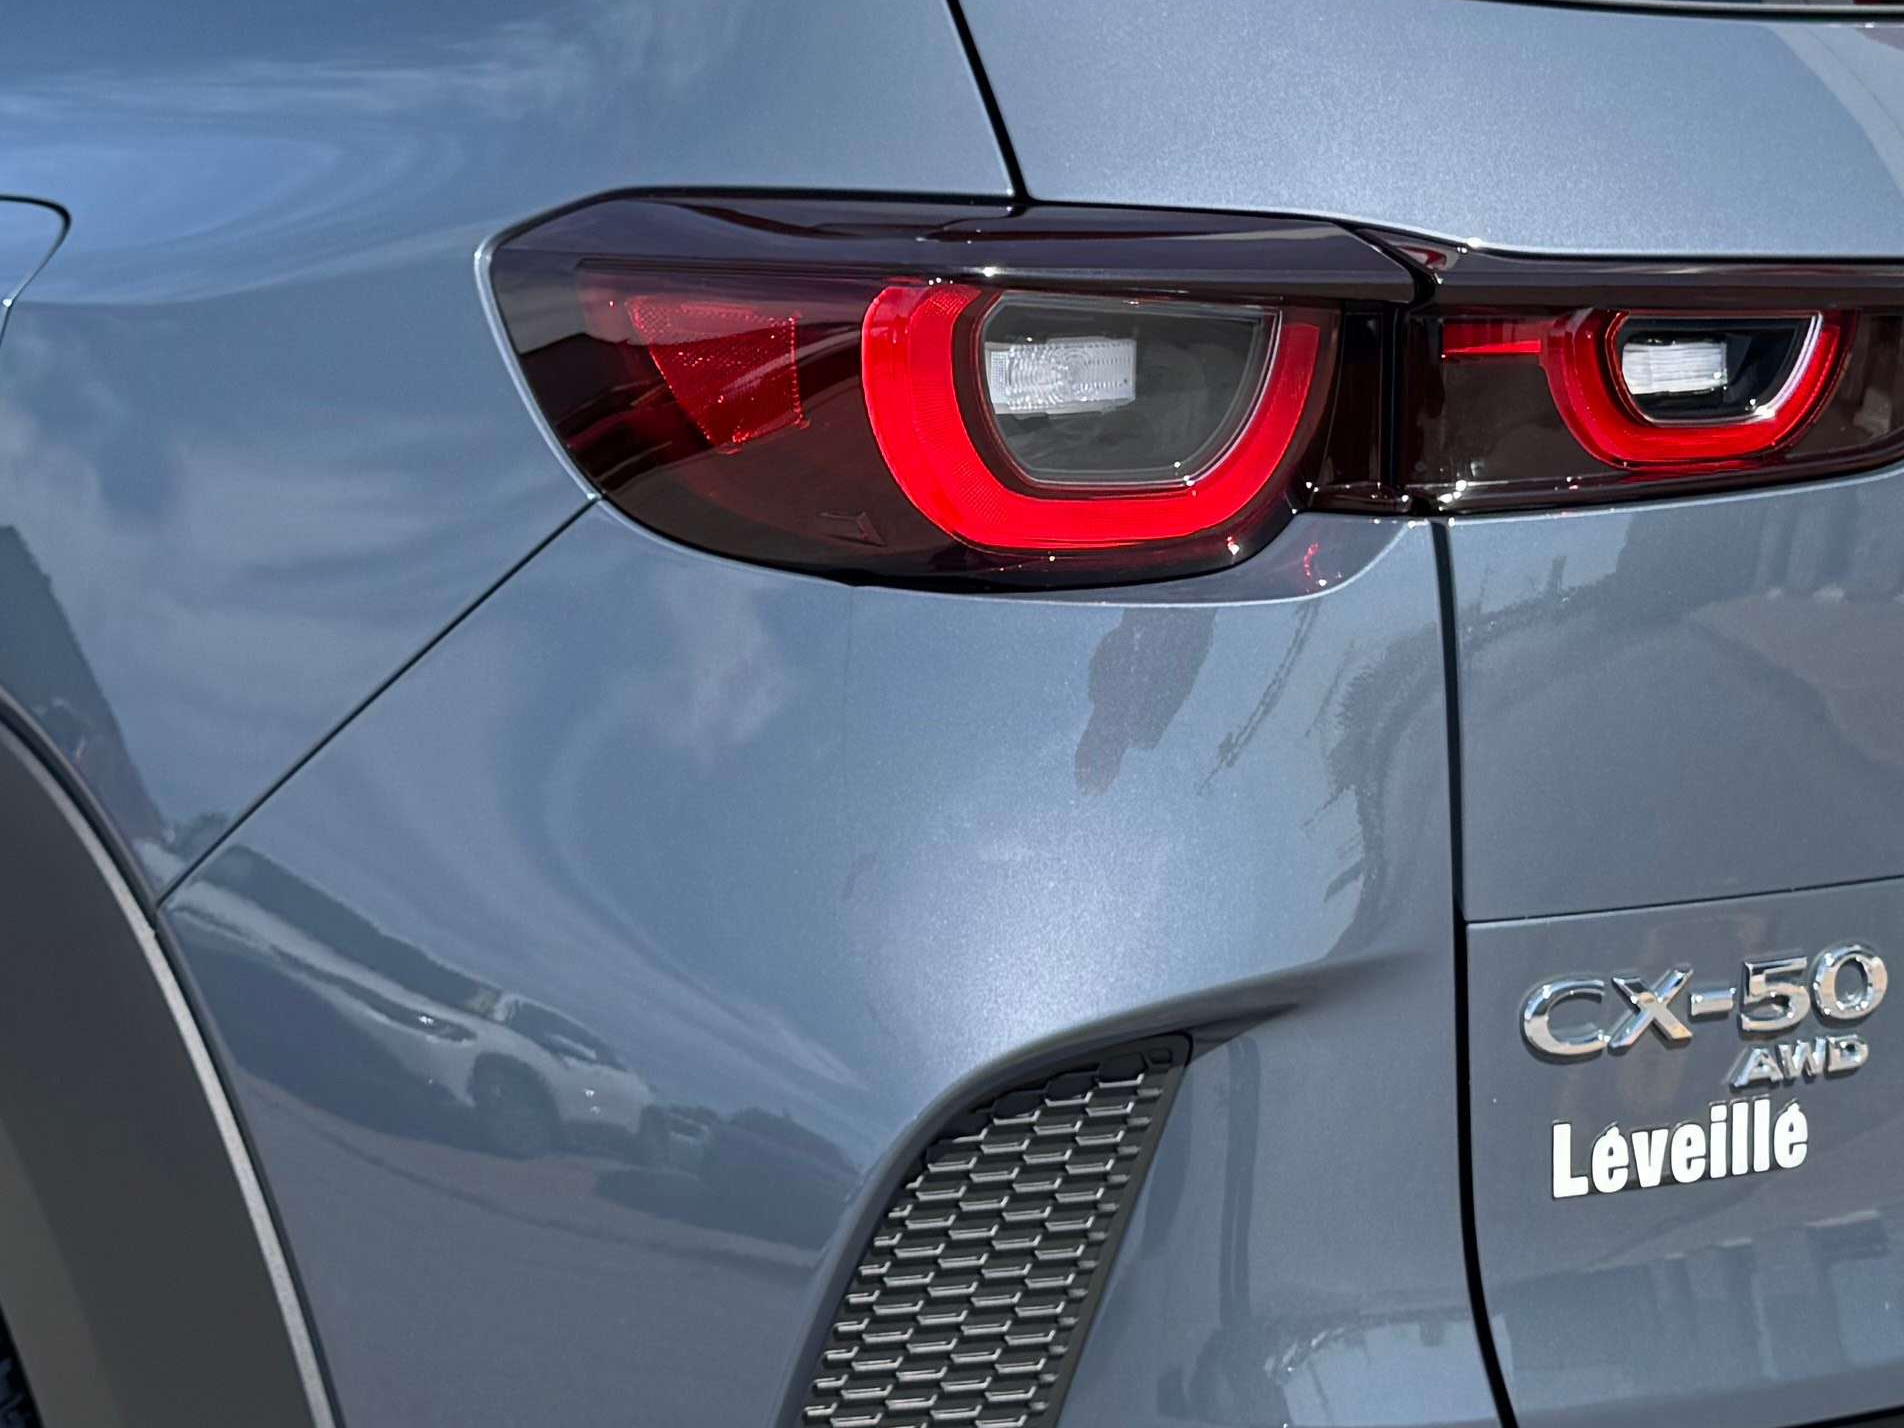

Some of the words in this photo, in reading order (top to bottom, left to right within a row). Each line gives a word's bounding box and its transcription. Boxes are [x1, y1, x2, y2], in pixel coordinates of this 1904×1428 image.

[1521, 941, 1889, 1058] CX-50
[1728, 1032, 1870, 1089] AWD
[1551, 1098, 1809, 1200] Léveillé
